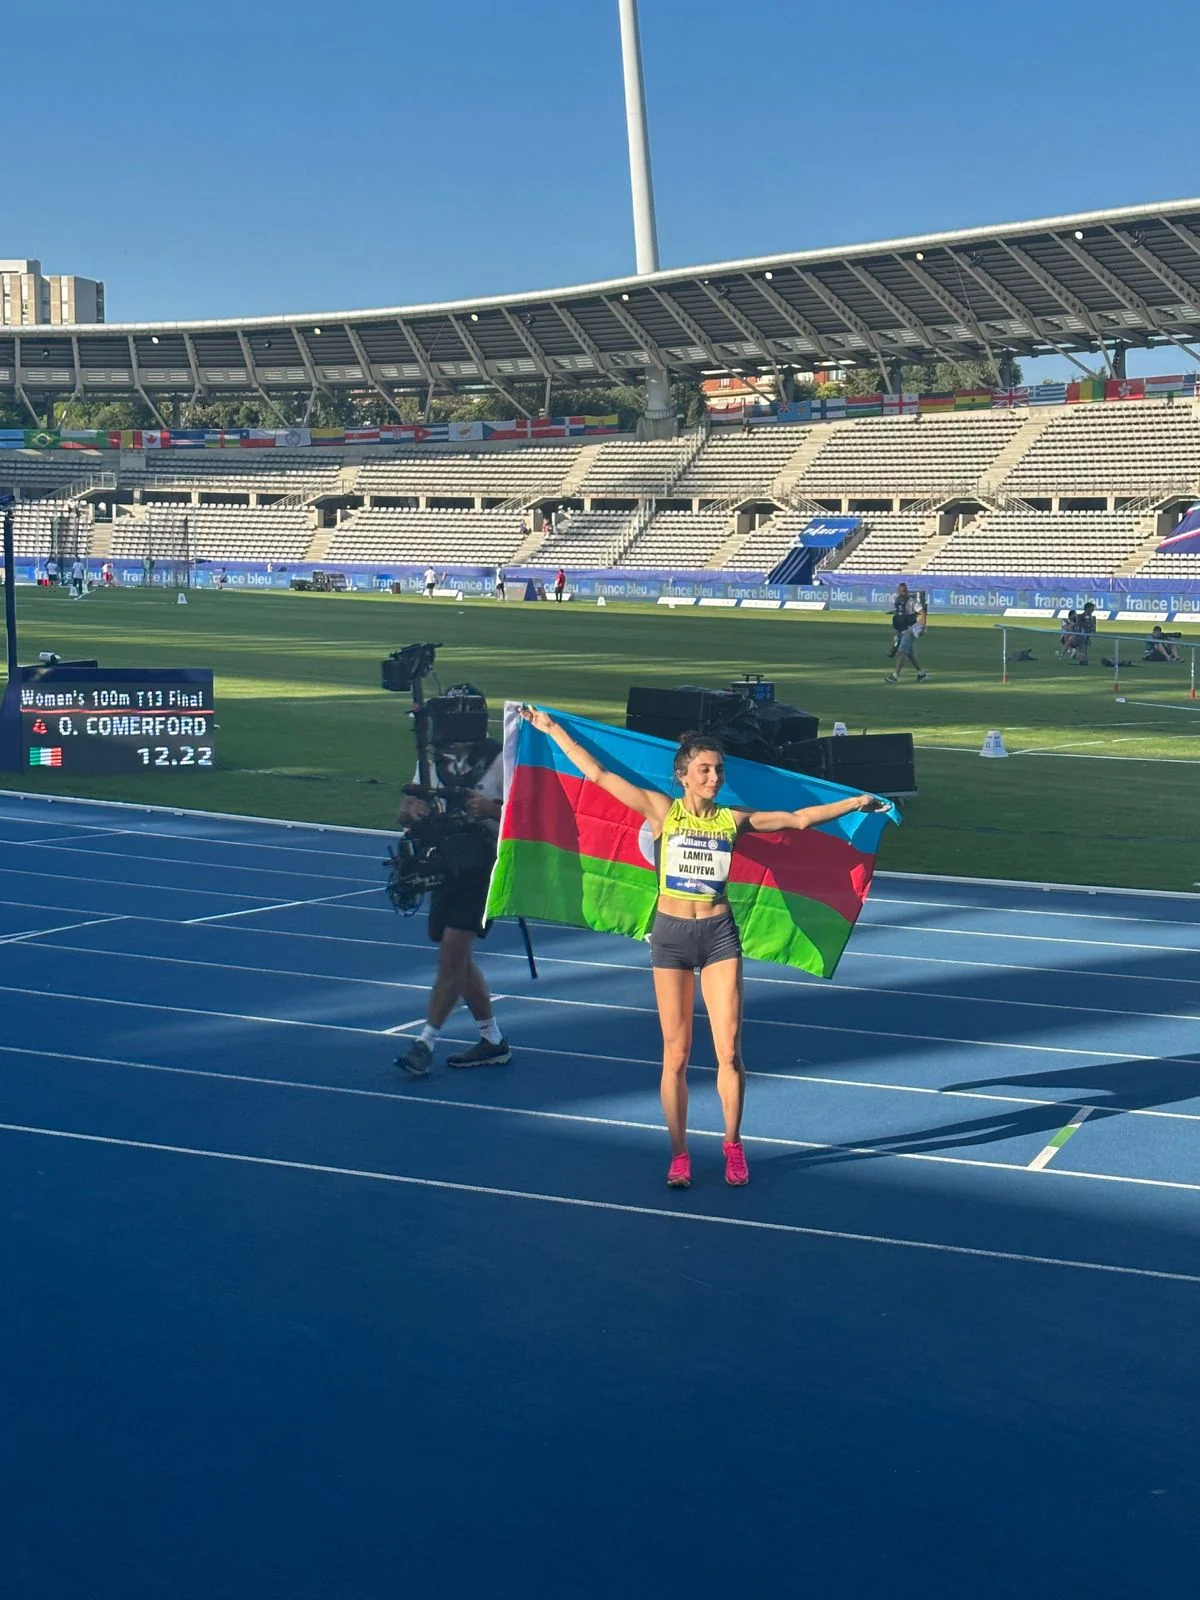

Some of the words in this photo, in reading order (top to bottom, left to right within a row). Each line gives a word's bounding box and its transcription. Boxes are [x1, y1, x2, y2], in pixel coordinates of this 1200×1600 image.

[247, 573, 272, 584] bleu
[409, 577, 424, 588] ble
[450, 577, 482, 590] france
[595, 583, 625, 594] france
[627, 583, 647, 595] bleu
[663, 584, 693, 596] france
[695, 585, 713, 597] bleu
[728, 586, 758, 598] france
[760, 587, 780, 599] bleu
[797, 588, 829, 600] france
[831, 588, 853, 601] bleu
[950, 591, 985, 605] france
[988, 592, 1013, 606] bleu
[1034, 593, 1073, 608] france
[1126, 595, 1168, 610] france
[1171, 596, 1200, 611] bleu
[21, 690, 85, 706] Women's
[92, 690, 130, 707] 100m
[136, 690, 163, 707] T13
[169, 690, 203, 707] Final
[59, 717, 78, 736] O.
[86, 717, 206, 737] COMERFORD
[136, 747, 212, 766] 12.22
[683, 850, 713, 862] LAMIYA
[678, 864, 715, 876] VALIYEVA
